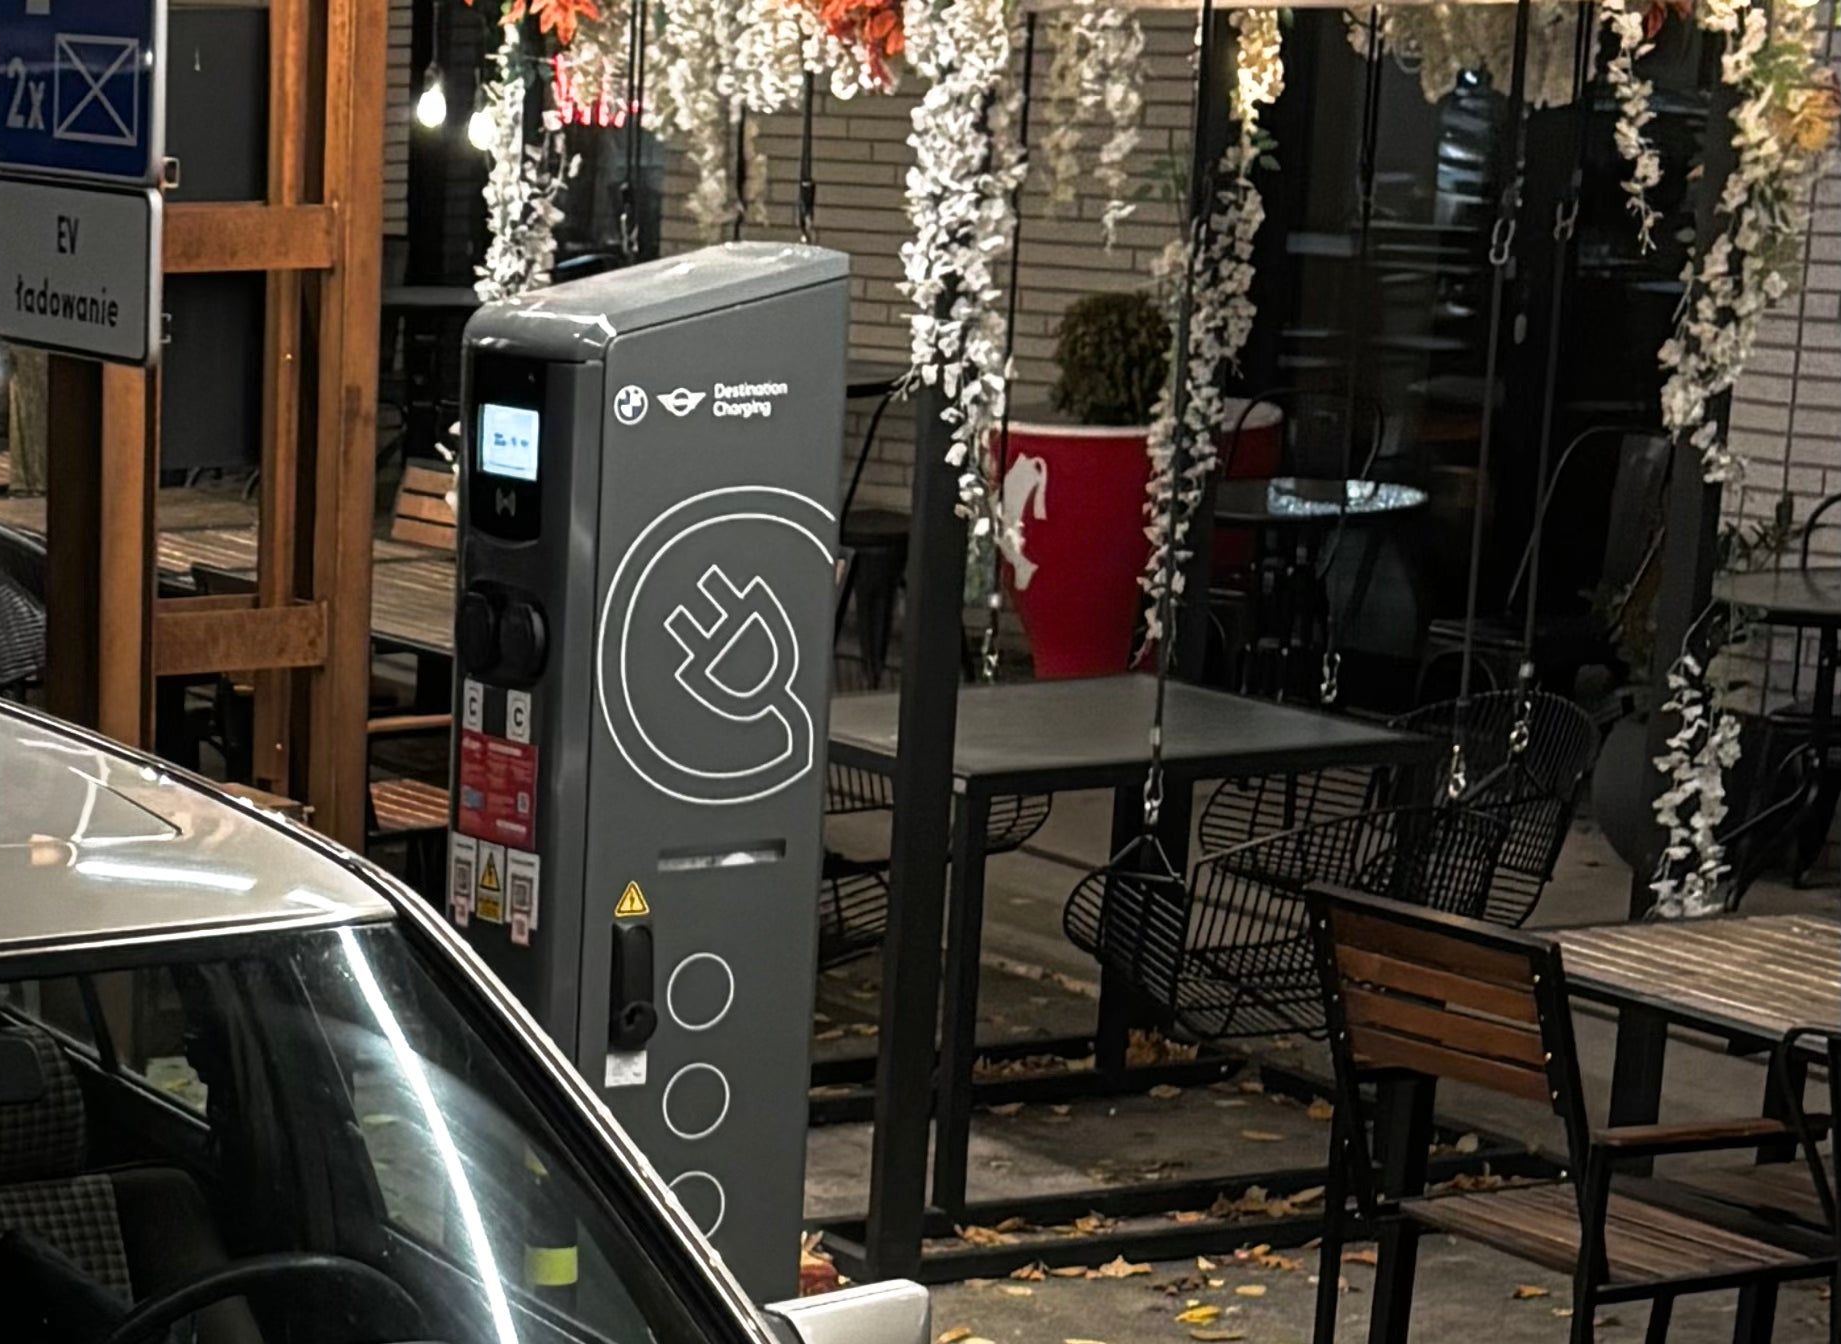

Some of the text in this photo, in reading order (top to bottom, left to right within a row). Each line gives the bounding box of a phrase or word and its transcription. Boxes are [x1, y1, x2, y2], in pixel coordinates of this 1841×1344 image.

[6, 57, 45, 131] 2x
[56, 215, 80, 255] EV
[713, 381, 789, 399] Destination
[712, 399, 772, 418] Charging
